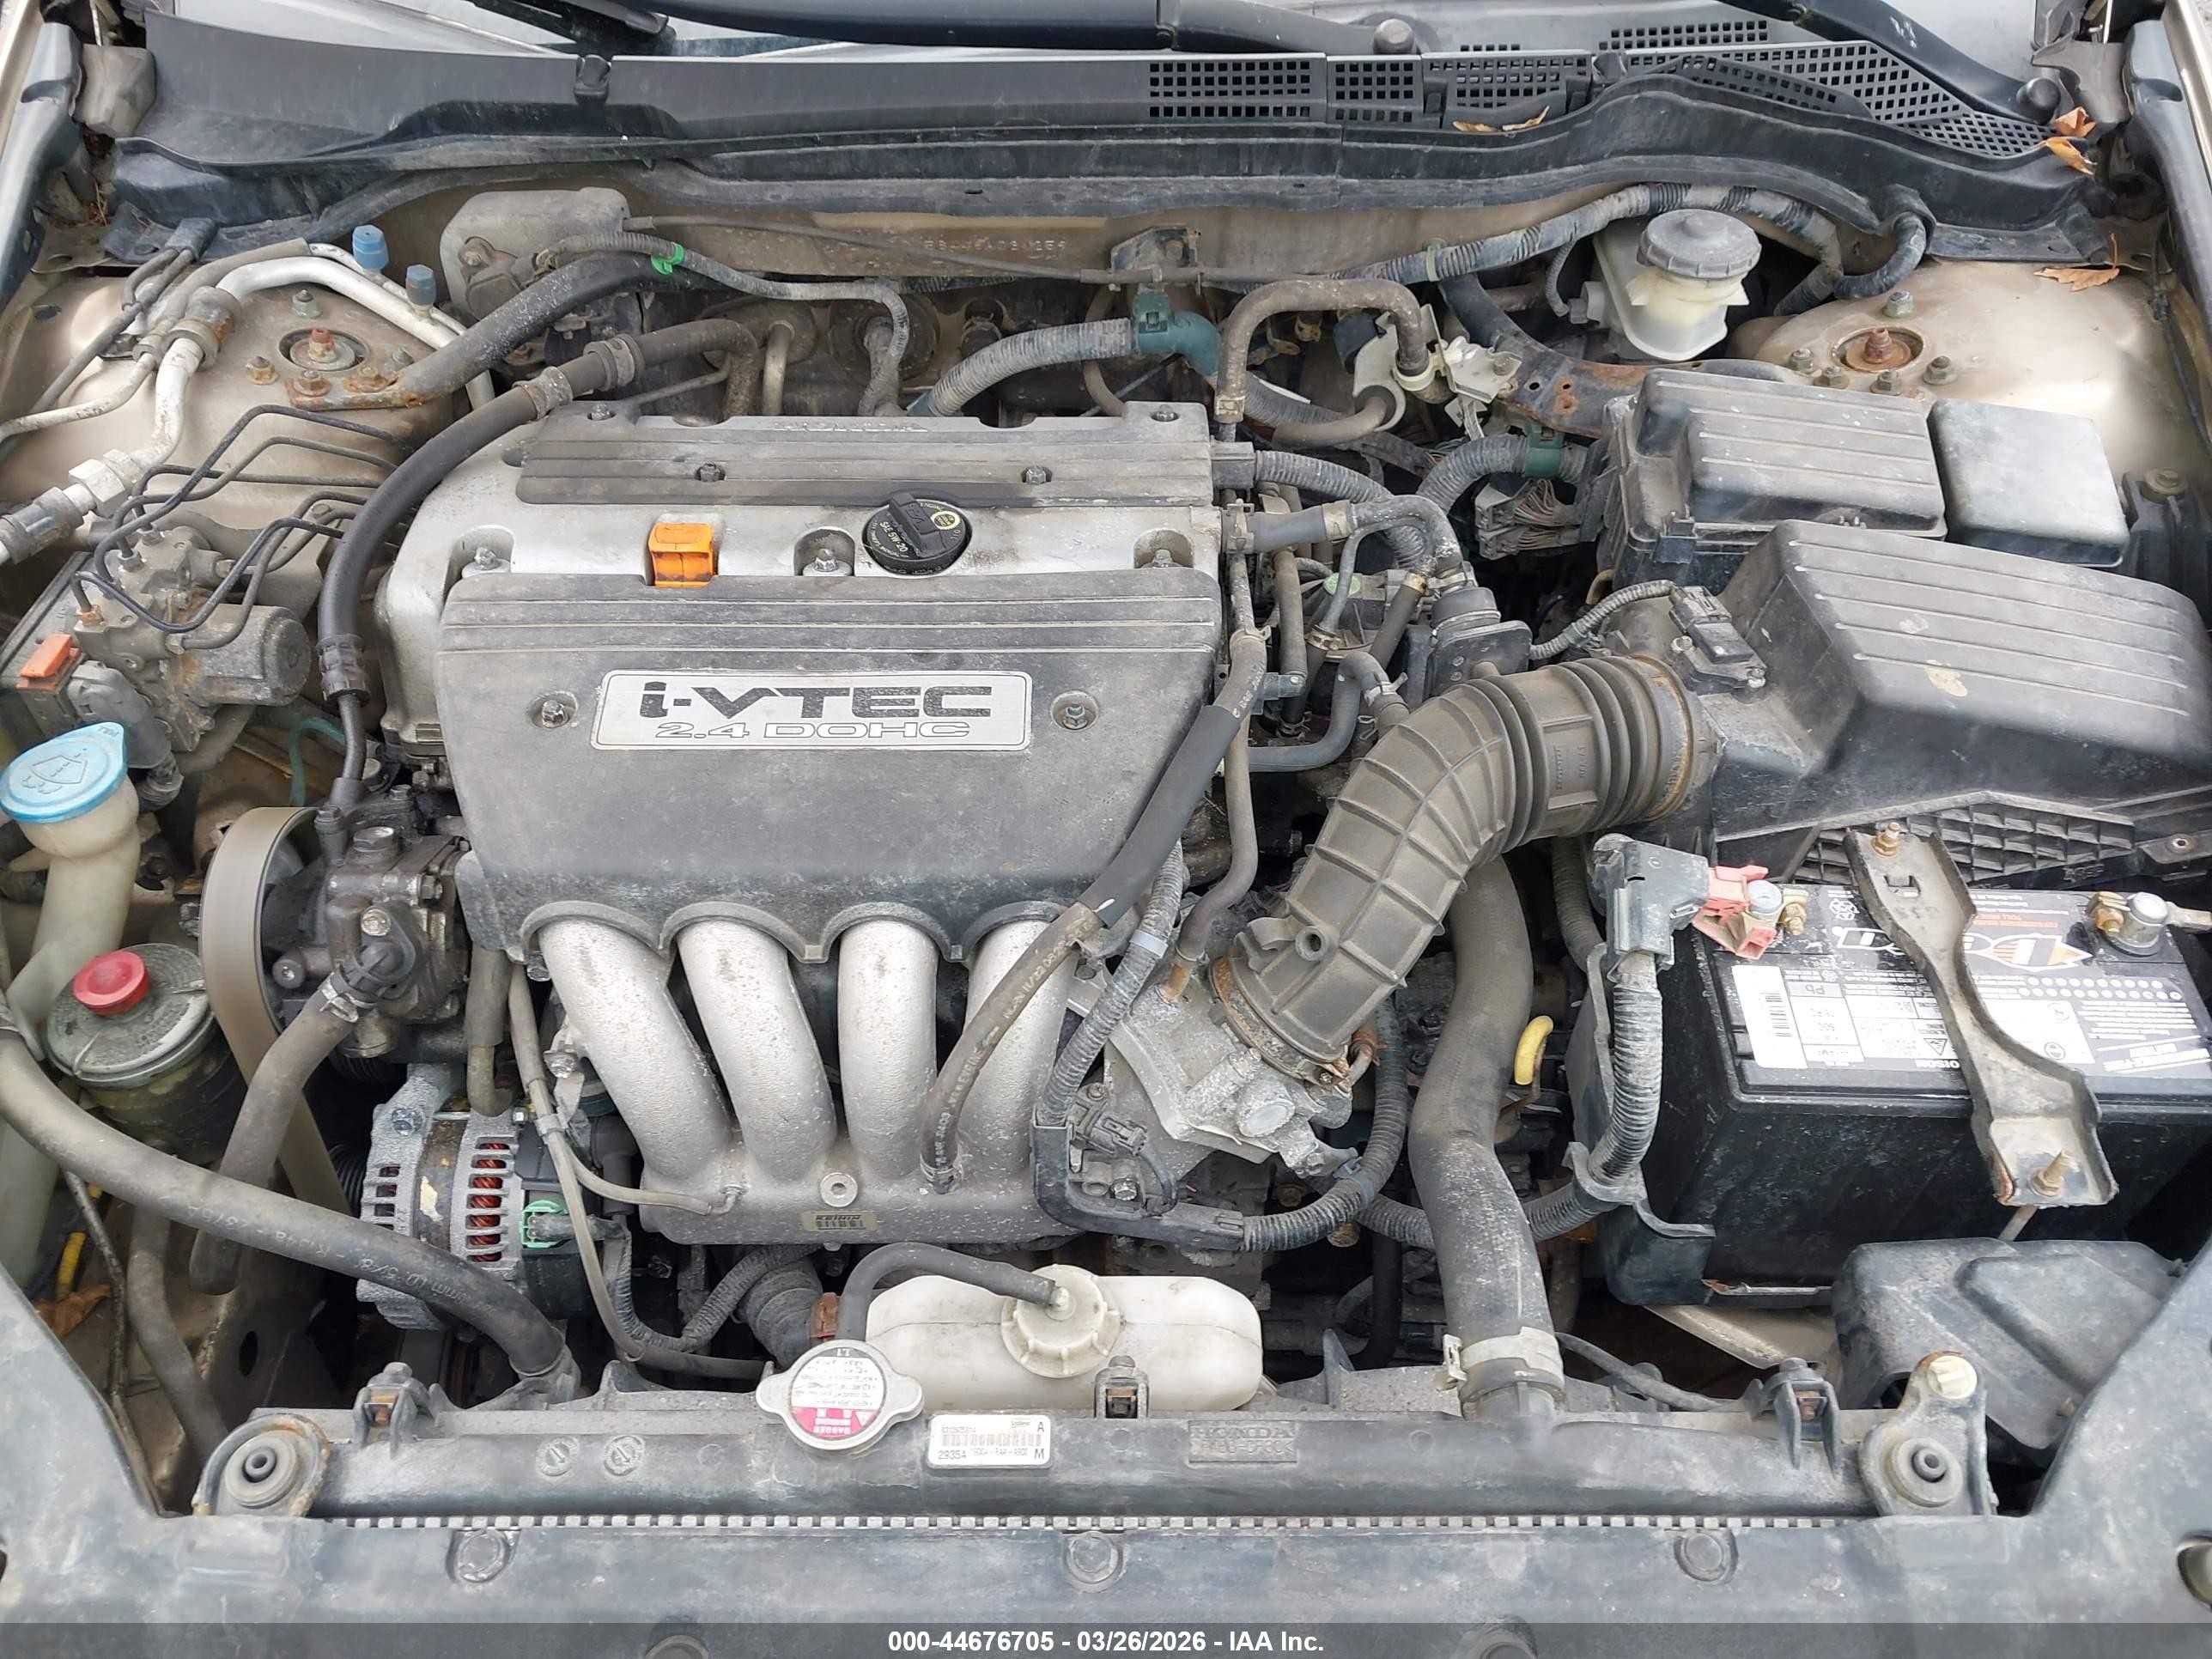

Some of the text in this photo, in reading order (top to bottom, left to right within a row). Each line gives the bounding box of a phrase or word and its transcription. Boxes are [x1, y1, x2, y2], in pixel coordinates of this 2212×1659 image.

[880, 521, 893, 533] SAE
[640, 681, 992, 719] i-VTEC
[655, 721, 969, 738] 2.4 DOHC
[1037, 1421, 1045, 1432] A
[1034, 1448, 1045, 1460] M
